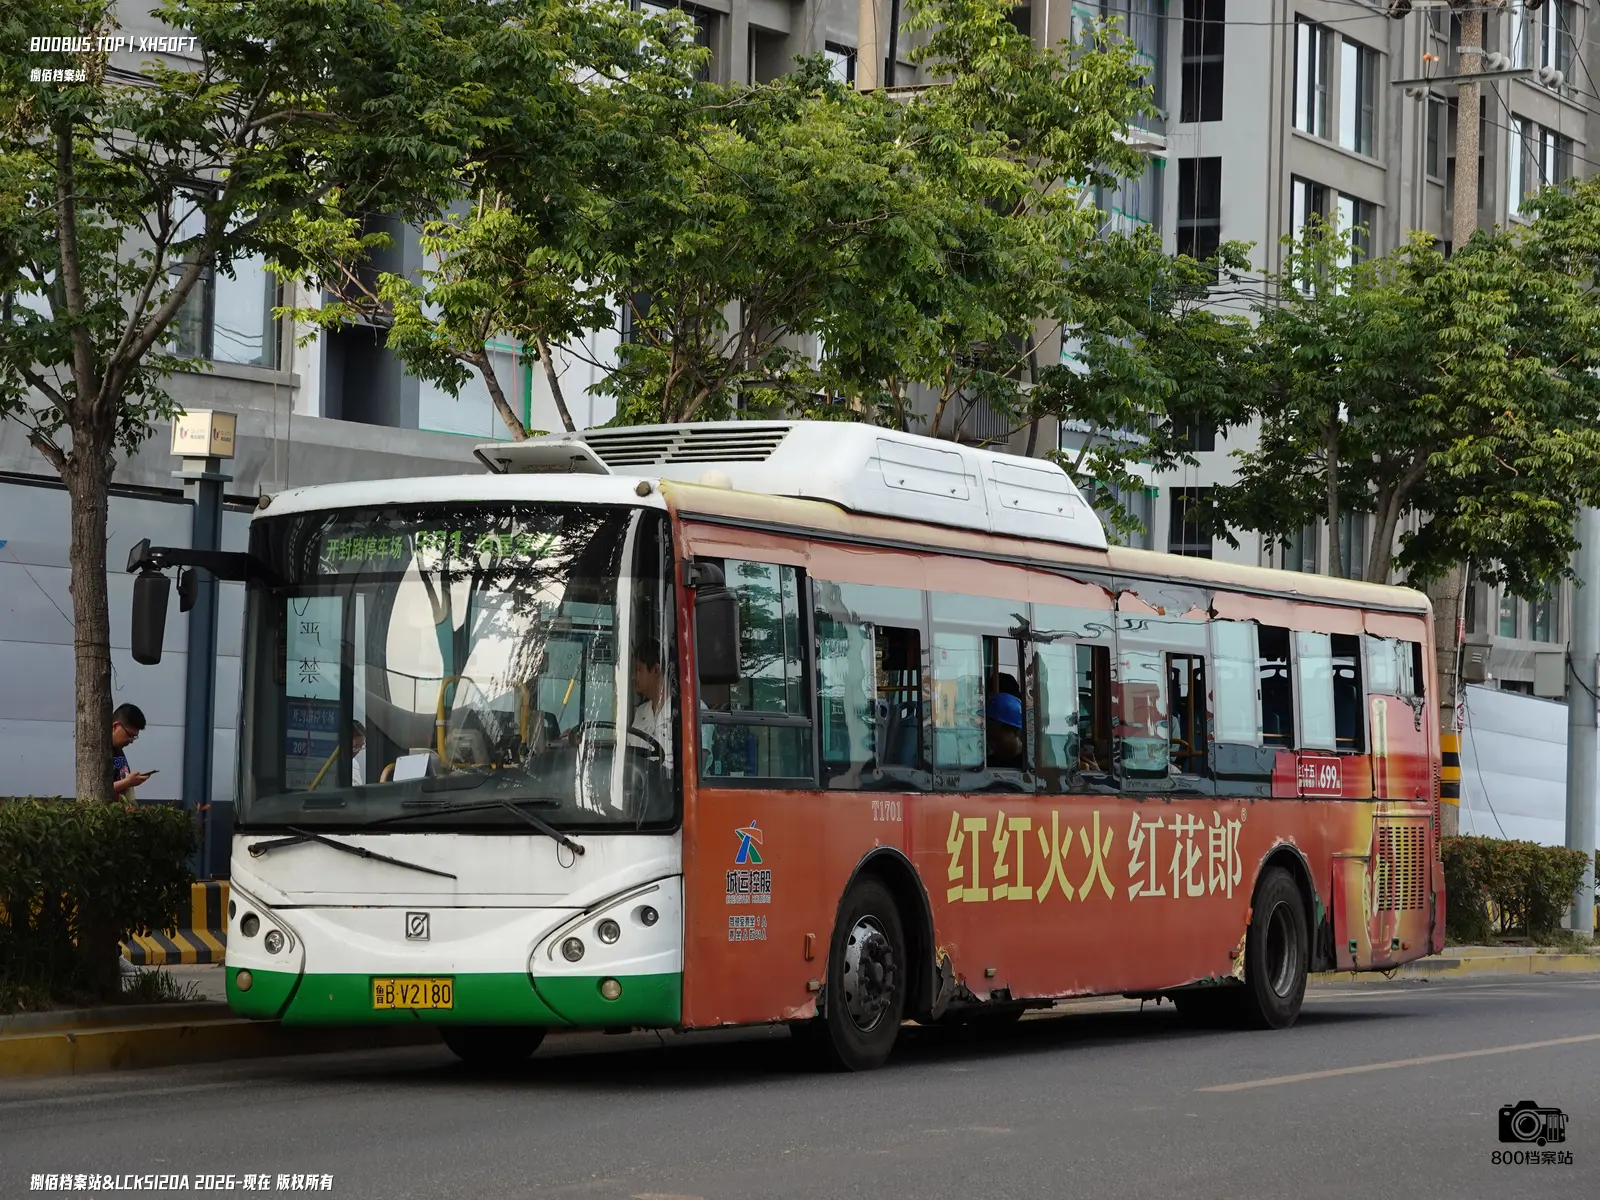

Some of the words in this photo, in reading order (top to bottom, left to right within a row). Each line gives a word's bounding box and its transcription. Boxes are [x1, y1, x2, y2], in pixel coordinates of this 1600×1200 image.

[326, 535, 404, 562] 开封路停车场
[871, 800, 902, 821] T1701
[946, 810, 1116, 904] 红红火火
[726, 869, 772, 895] 城运控股
